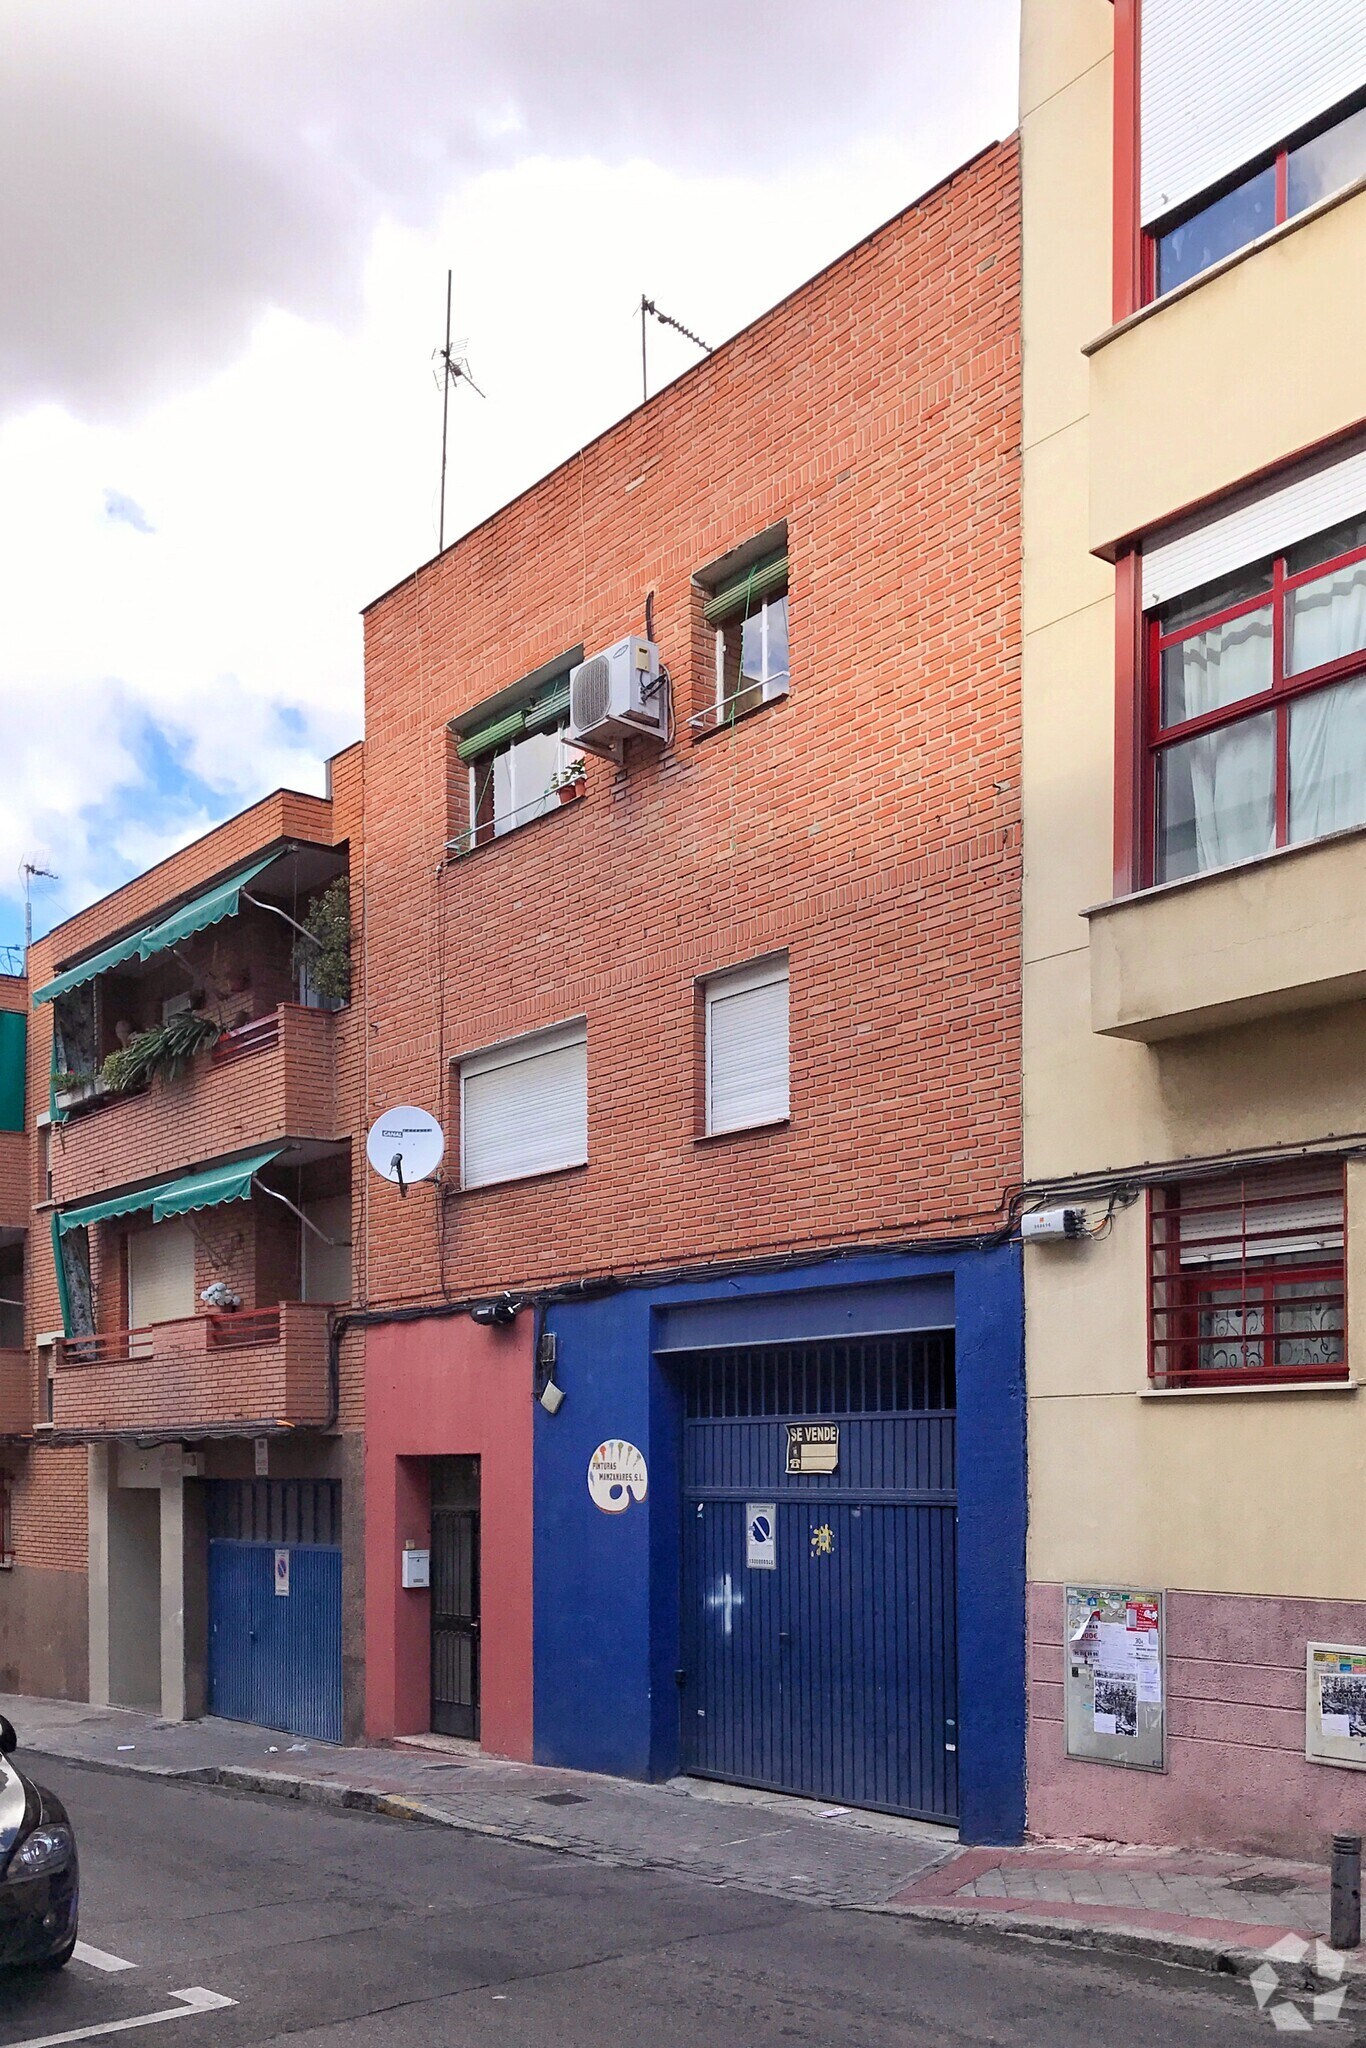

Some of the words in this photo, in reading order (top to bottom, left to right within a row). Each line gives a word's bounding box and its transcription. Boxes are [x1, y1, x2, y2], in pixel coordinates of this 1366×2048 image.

[790, 1427, 803, 1442] SE
[805, 1426, 837, 1442] VENDE
[592, 1462, 617, 1470] PINTURAS
